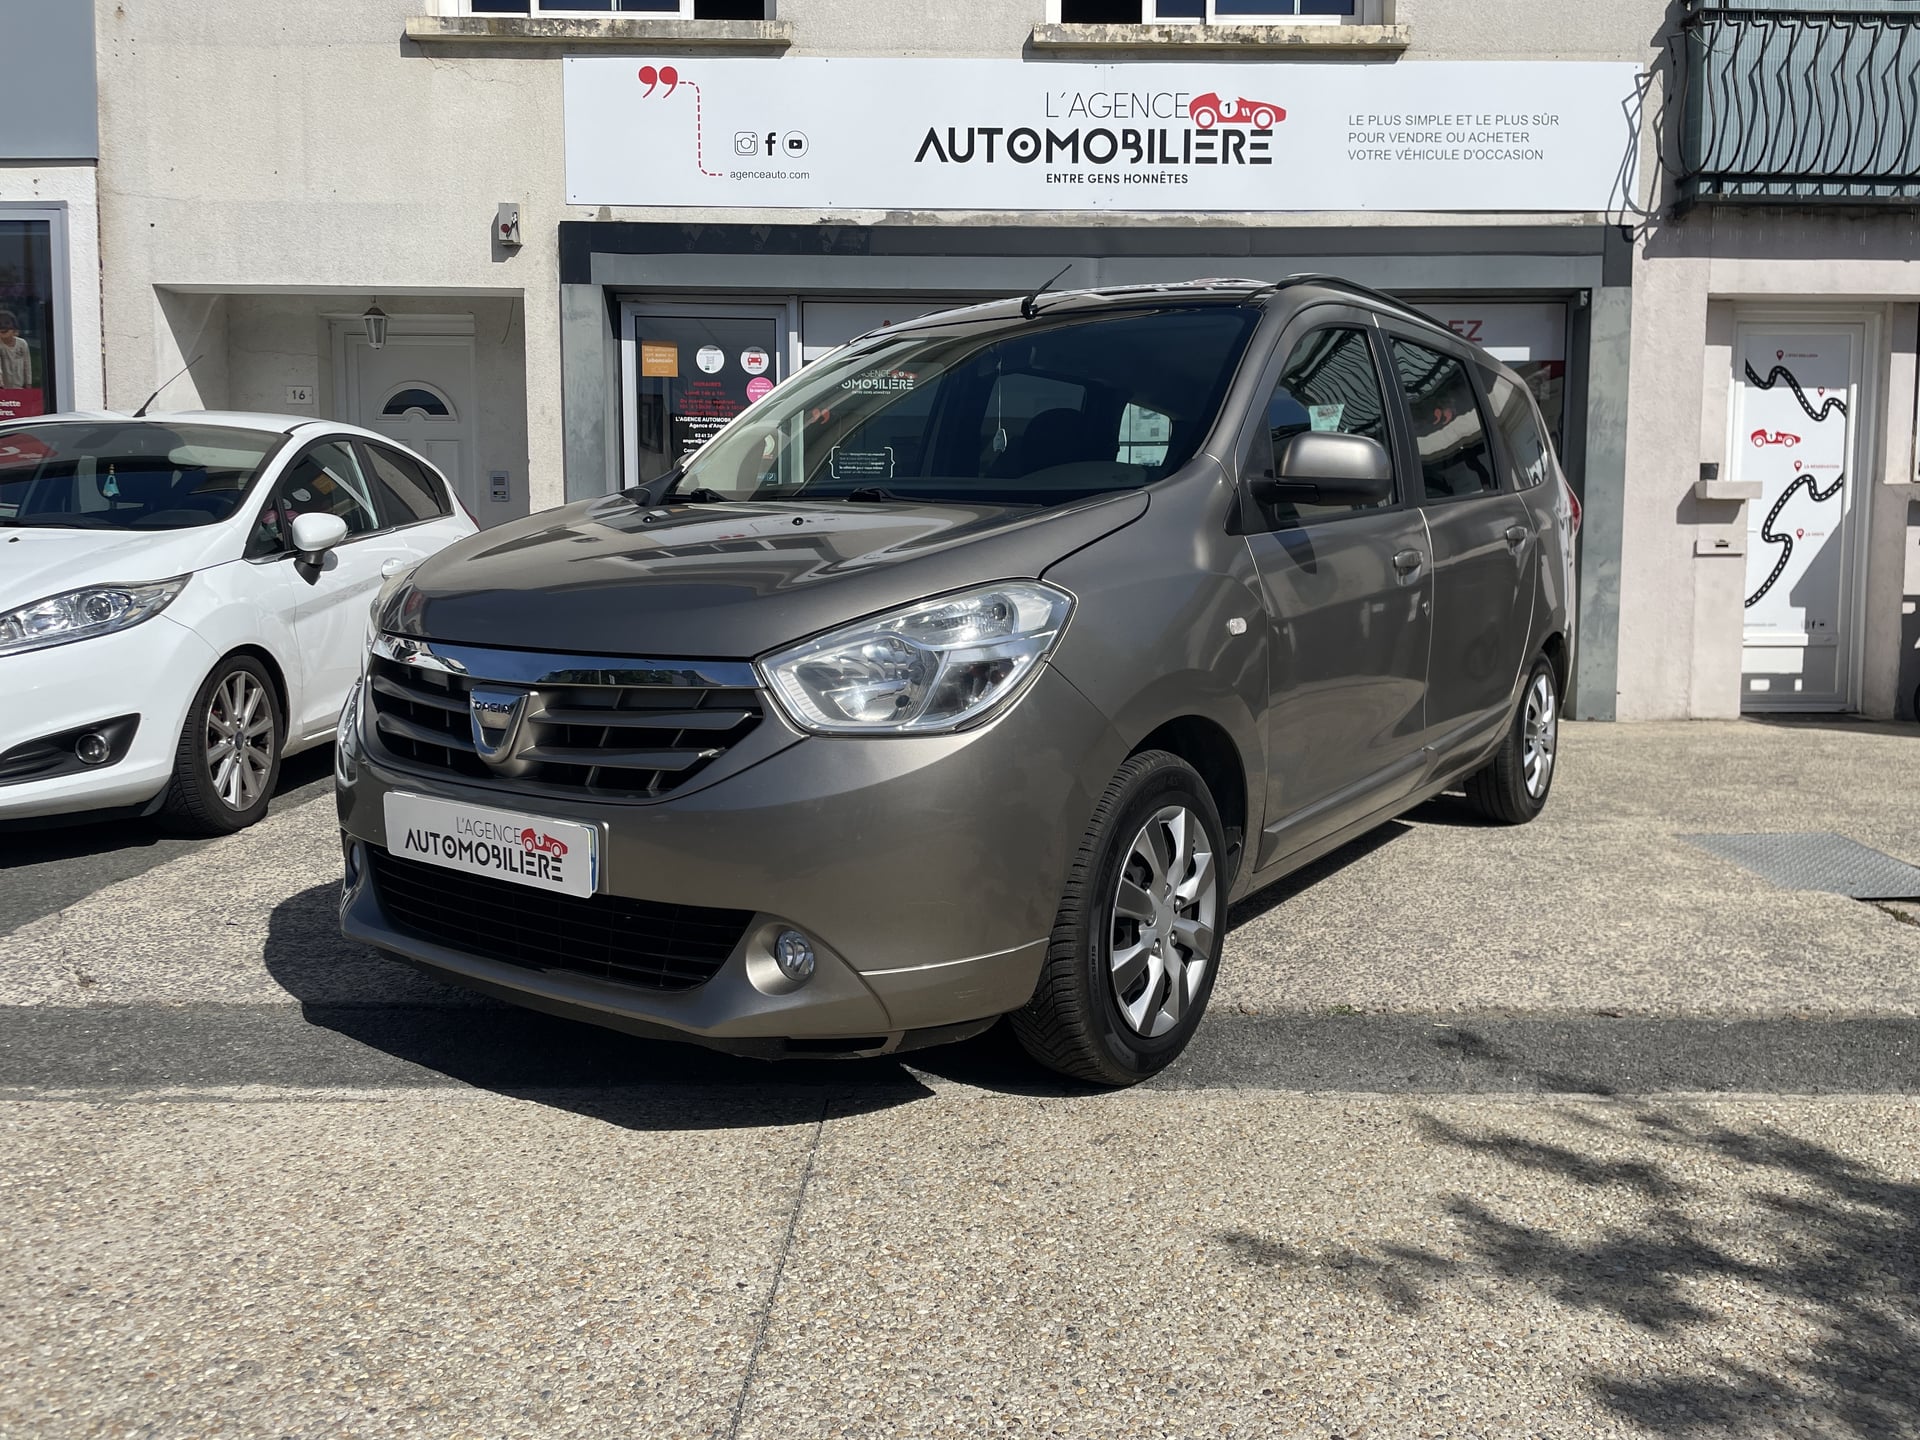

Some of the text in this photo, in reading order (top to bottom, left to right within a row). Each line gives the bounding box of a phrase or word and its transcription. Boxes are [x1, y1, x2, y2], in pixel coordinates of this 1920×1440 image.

[1046, 92, 1189, 119] L'AGENCE
[1225, 102, 1231, 114] 1
[1348, 112, 1560, 126] LE PLUS SIMPLE ET LE PLUS SÛR
[1348, 131, 1530, 144] POUR VENDRE OU ACHETER
[1347, 146, 1544, 161] VOTRE VÉHICULE D'OCCASION
[729, 169, 810, 181] agenceauto.com
[1046, 170, 1189, 184] ENTRE GENS HONNÊTES
[292, 389, 306, 401] 16
[474, 700, 511, 715] DACIA
[456, 816, 522, 846] L'AGENCE
[537, 835, 542, 845] 1
